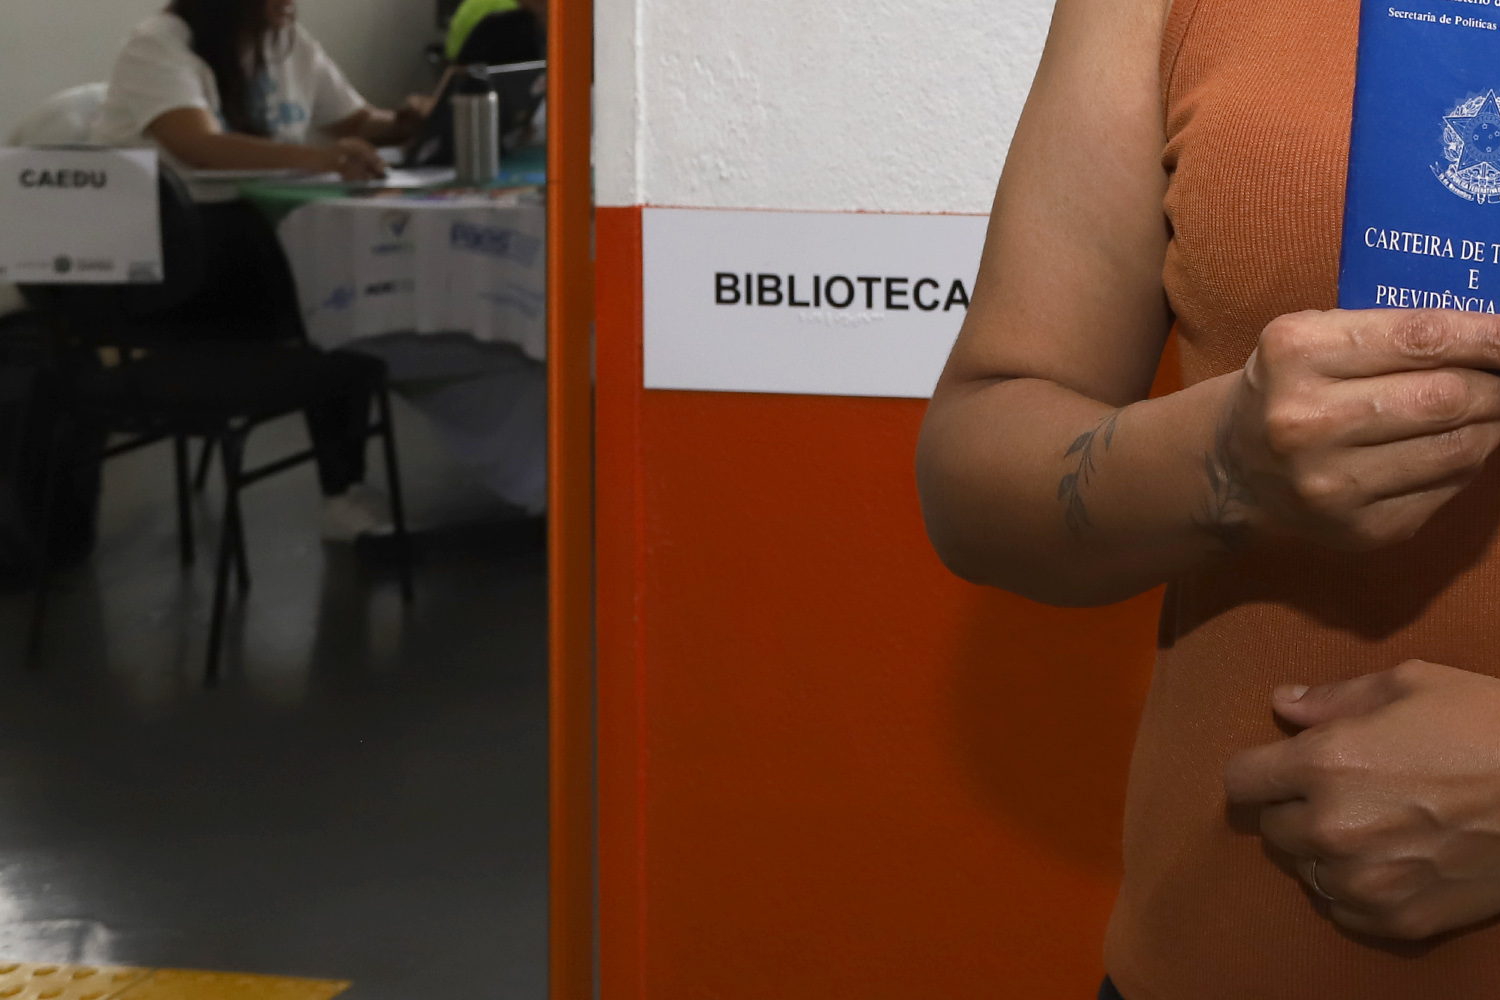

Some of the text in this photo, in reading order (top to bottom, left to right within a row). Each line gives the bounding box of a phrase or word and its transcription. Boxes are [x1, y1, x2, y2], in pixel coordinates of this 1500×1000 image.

[1388, 7, 1436, 23] Secretaria
[1439, 14, 1452, 25] de
[1455, 16, 1497, 31] Políticas
[19, 168, 108, 190] CAEDU
[1364, 227, 1454, 259] CARTEIRA
[1460, 239, 1485, 263] DE
[714, 272, 970, 312] BIBLIOTECA
[1468, 268, 1480, 290] E
[1375, 285, 1496, 315] PREVIDÊNCIA
